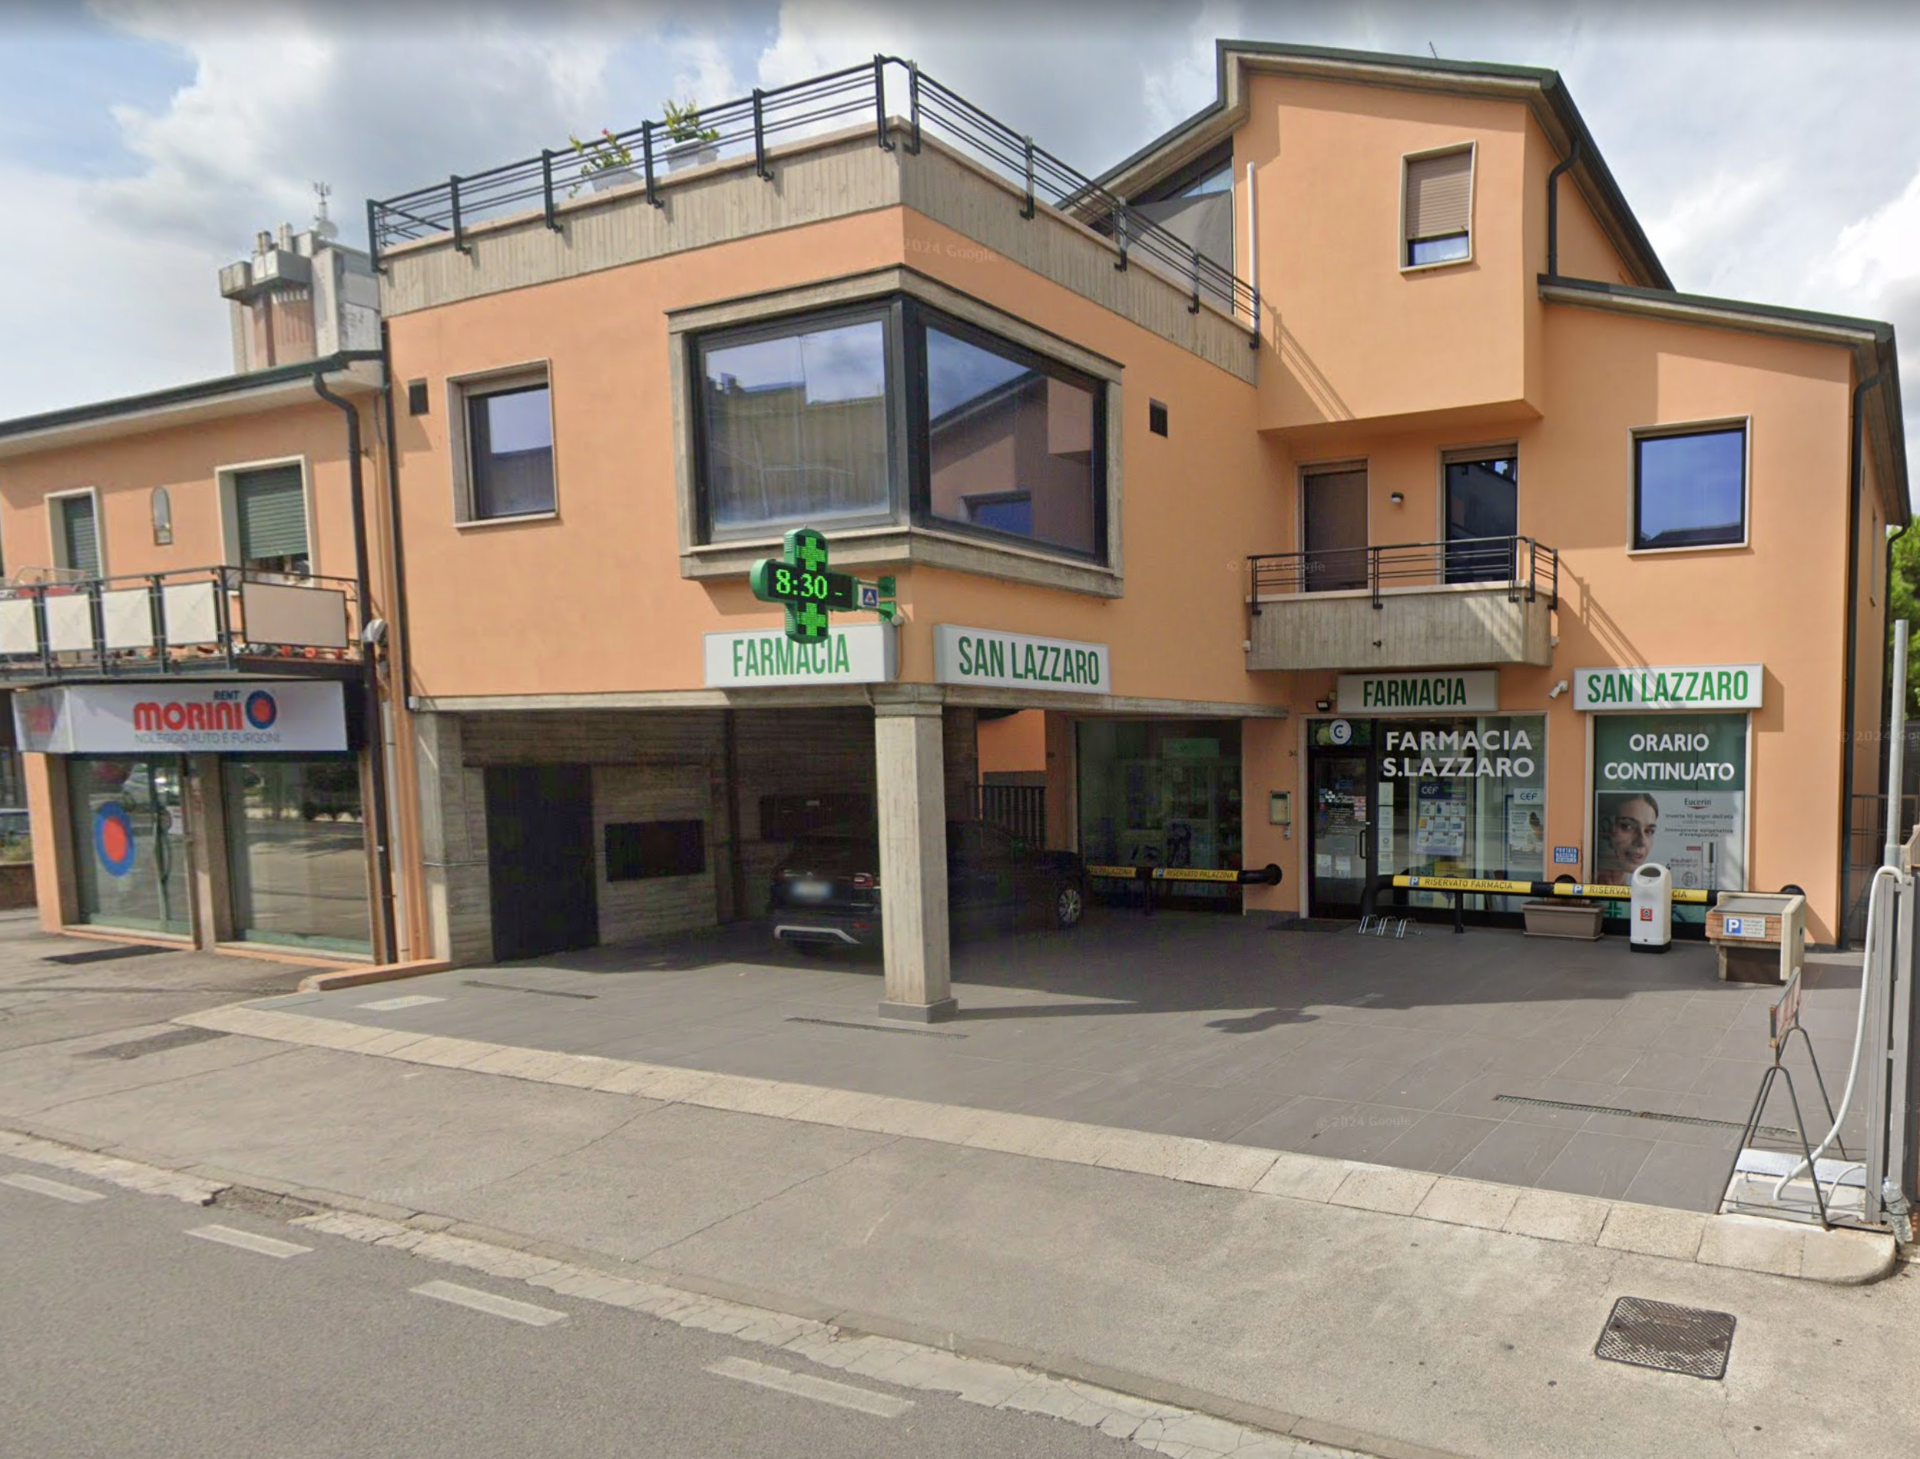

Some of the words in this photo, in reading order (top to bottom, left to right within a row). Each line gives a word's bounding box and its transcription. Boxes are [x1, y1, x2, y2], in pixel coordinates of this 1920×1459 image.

[775, 569, 828, 599] 8:30
[732, 633, 850, 677] FARMACIA
[958, 635, 1003, 677] SAN
[1011, 643, 1100, 686] LAZZARO
[213, 690, 241, 700] RENT
[1363, 678, 1467, 707] FARMACIA
[1587, 674, 1633, 703] SAN
[1641, 670, 1748, 702] LAZZARO
[135, 732, 188, 744] NOLEGGIO
[191, 733, 219, 744] AUTO
[1386, 730, 1532, 751] FARMACIA
[1629, 733, 1709, 752] ORARIO
[1383, 757, 1535, 778] S.LAZZARO
[1604, 762, 1735, 781] CONTINUATO
[1684, 797, 1712, 806] Eucerin
[1425, 878, 1468, 887] RISERVATO
[1471, 880, 1513, 890] FARMACIA
[1589, 886, 1632, 895] RISERVAT
[1728, 919, 1739, 932] P
